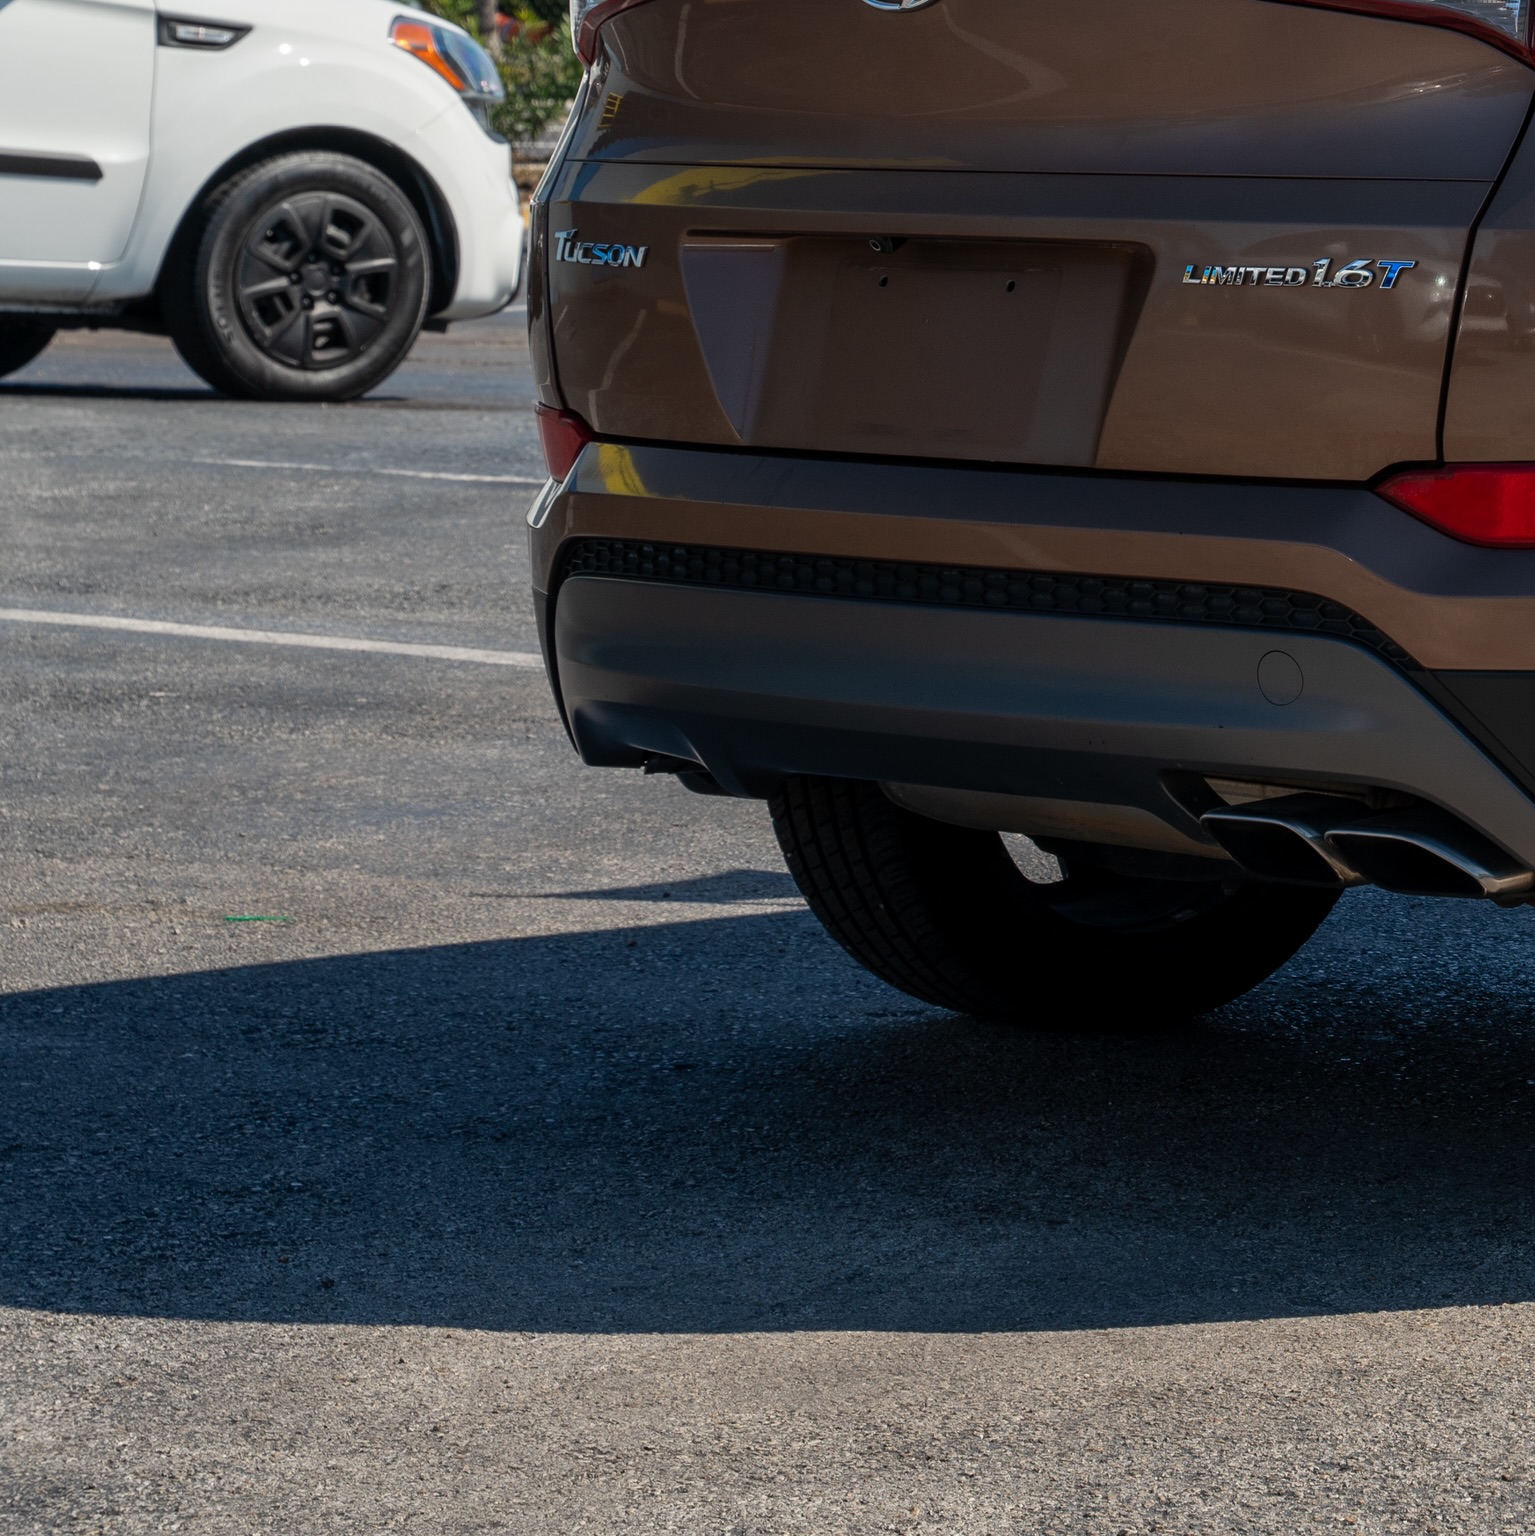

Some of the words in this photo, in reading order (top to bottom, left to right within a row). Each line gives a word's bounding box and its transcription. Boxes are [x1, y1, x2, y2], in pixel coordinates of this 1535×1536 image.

[555, 228, 648, 268] TUCSON
[1182, 264, 1307, 287] LIMITED
[1311, 258, 1416, 289] 1.6T
